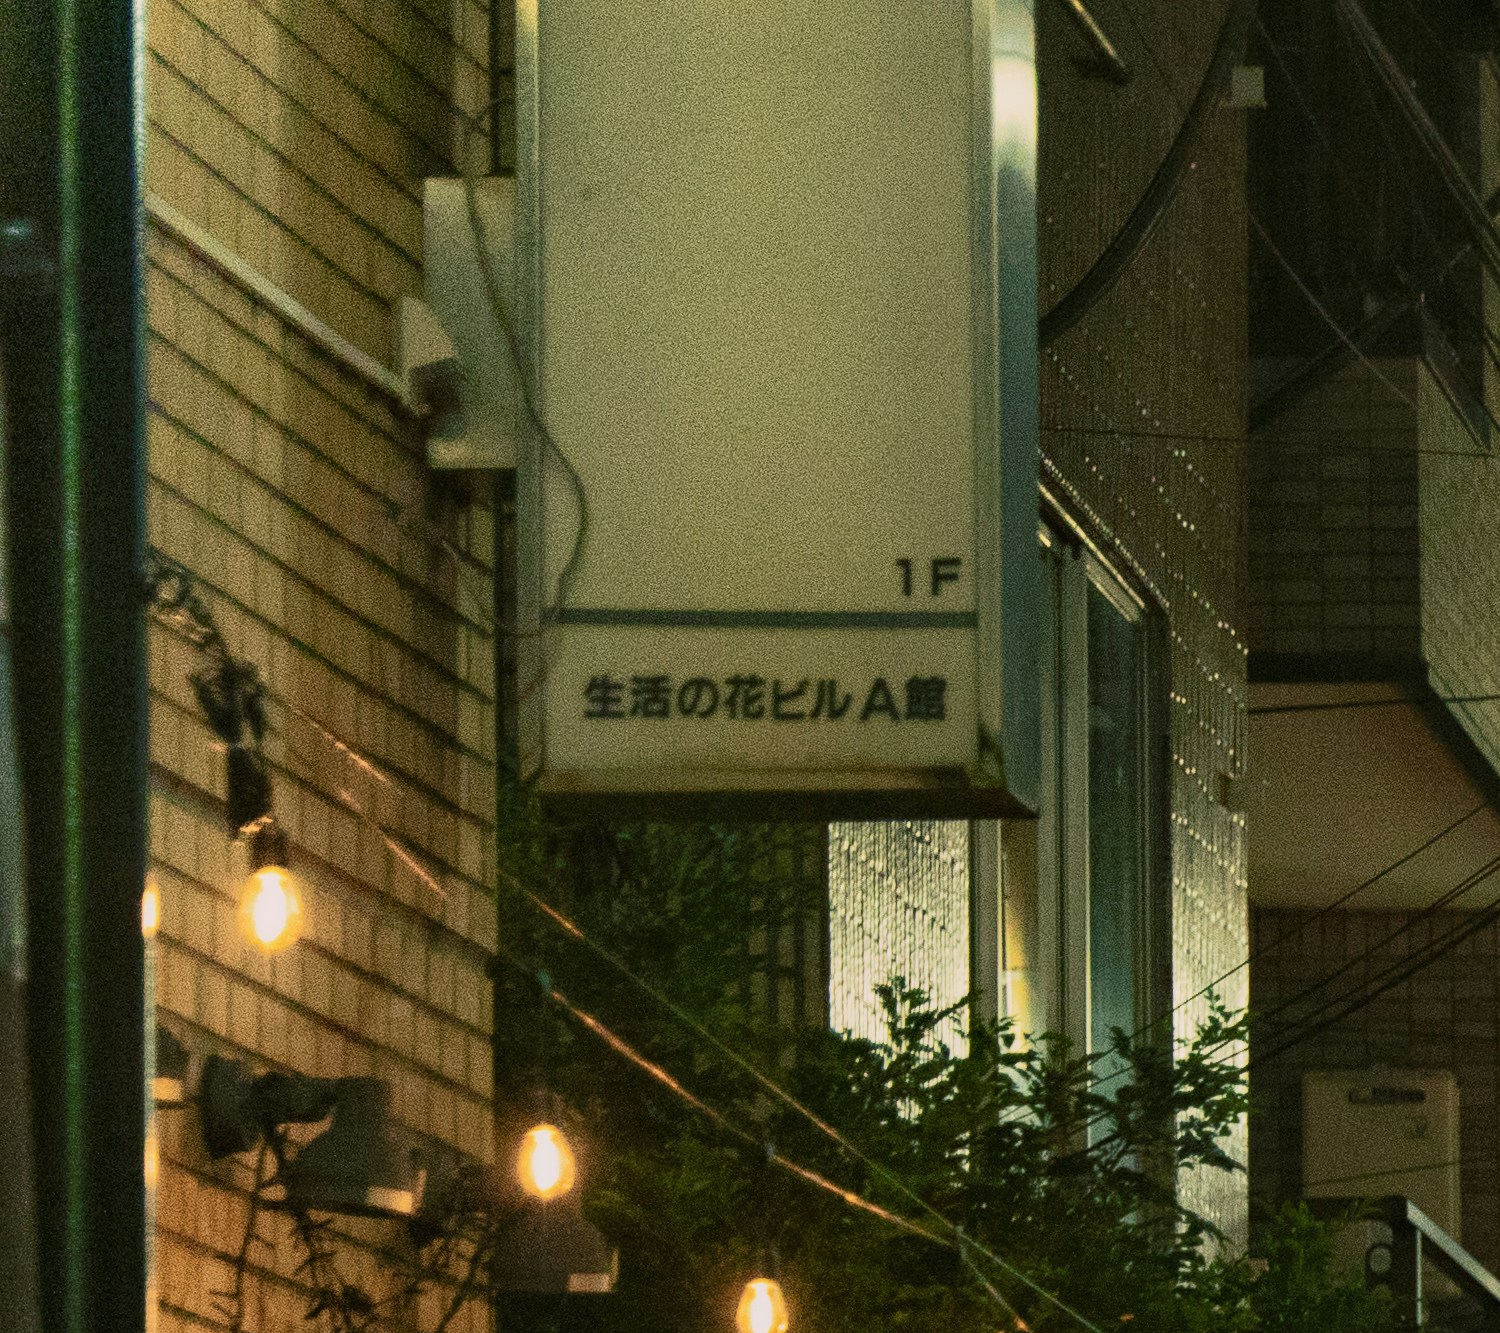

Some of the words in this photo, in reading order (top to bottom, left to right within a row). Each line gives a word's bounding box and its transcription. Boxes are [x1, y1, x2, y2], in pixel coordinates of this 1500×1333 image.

[896, 558, 961, 597] 1F
[583, 673, 947, 722] 生活の花ビルA館
